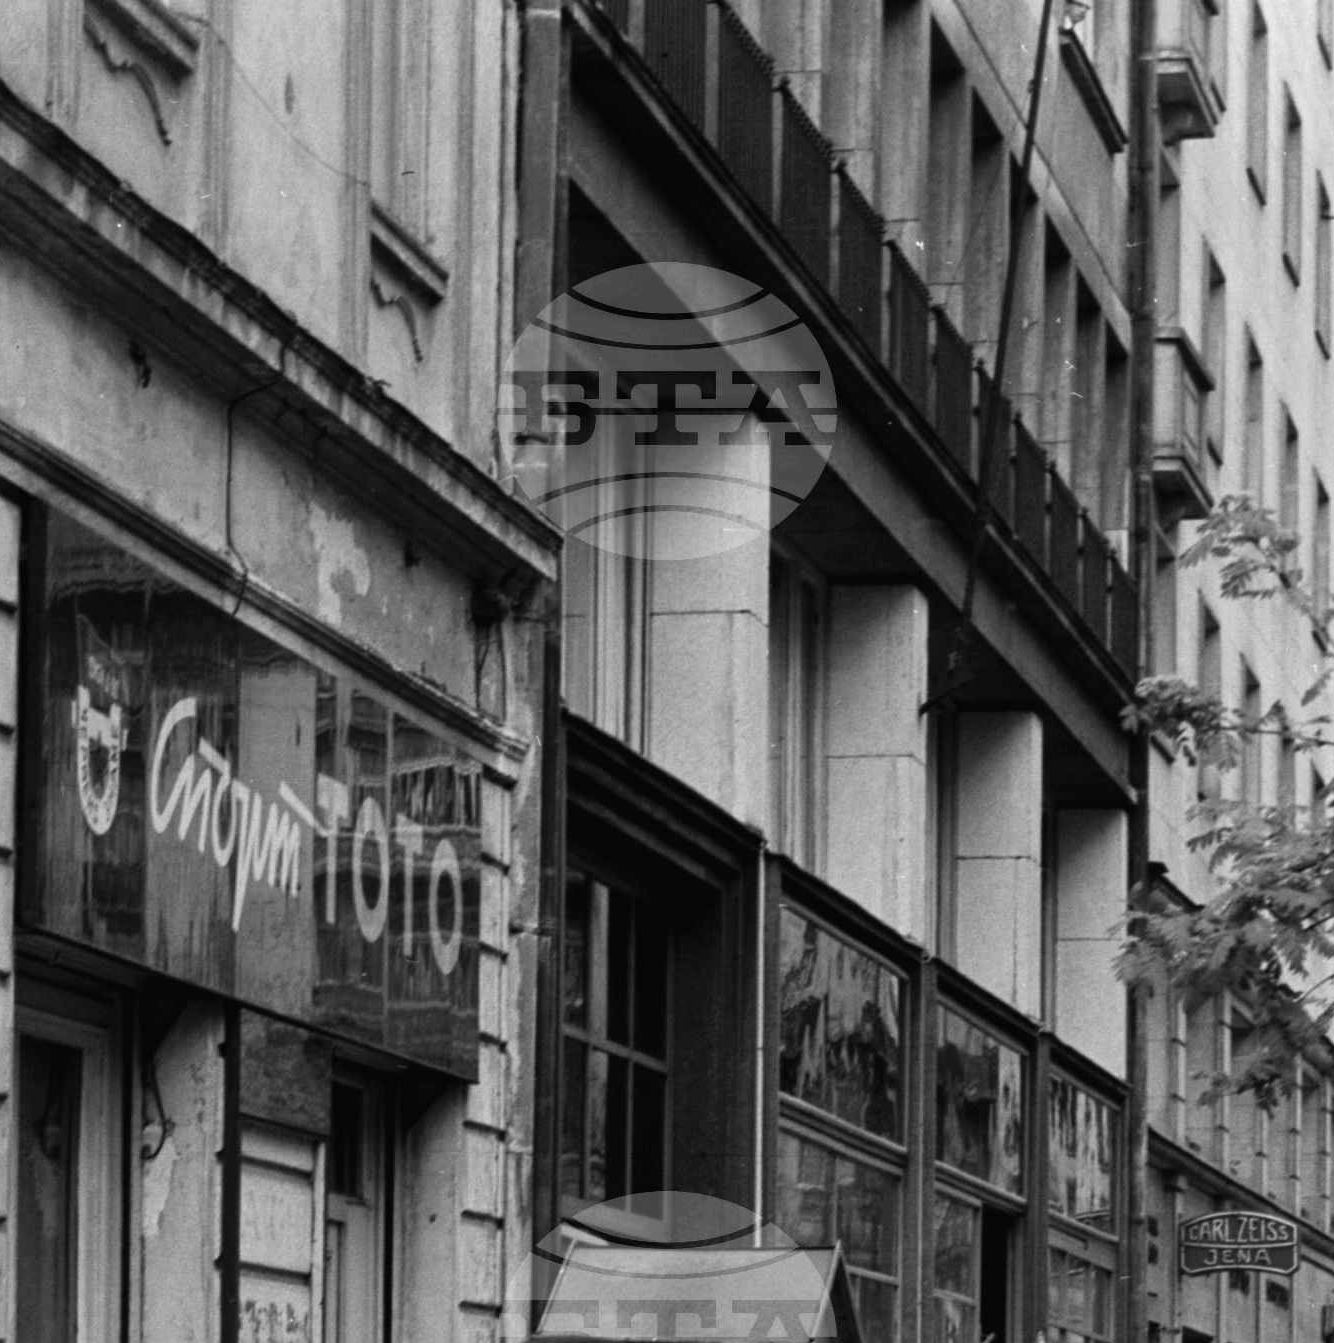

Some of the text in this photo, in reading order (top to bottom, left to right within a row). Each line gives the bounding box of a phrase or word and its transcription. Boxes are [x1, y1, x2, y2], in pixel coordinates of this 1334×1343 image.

[317, 773, 464, 976] ТОТО
[1189, 1216, 1289, 1242] CARL ZEISS
[1203, 1248, 1271, 1266] JENA
